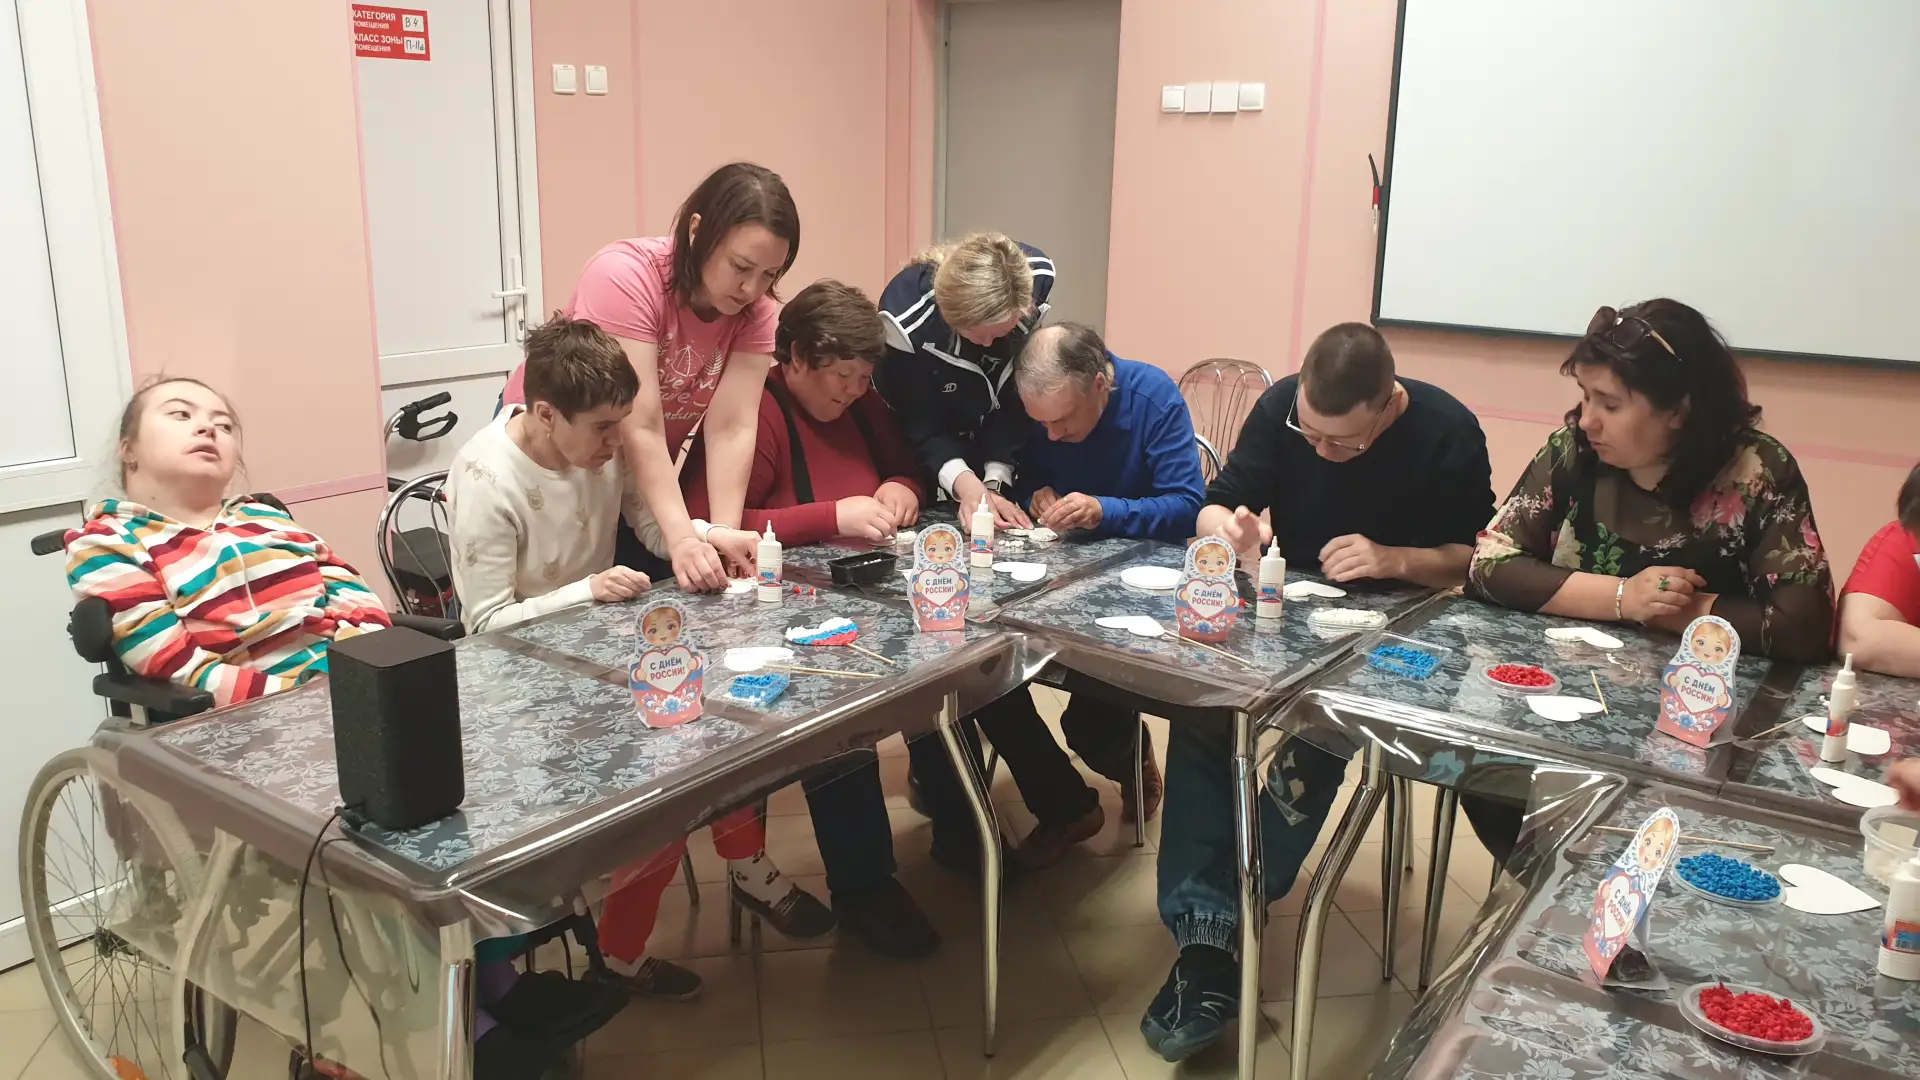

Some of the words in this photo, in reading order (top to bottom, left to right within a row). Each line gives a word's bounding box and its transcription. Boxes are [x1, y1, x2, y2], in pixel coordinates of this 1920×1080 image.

[381, 35, 403, 45] ЗОНЫ
[932, 577, 952, 586] ДНЁМ
[925, 586, 954, 594] РОССИИ!
[1194, 588, 1199, 596] С
[1201, 588, 1223, 599] ДНЁМ
[1191, 597, 1223, 607] РОССИИ!
[650, 662, 657, 670] С
[658, 657, 683, 670] ДНЁМ
[650, 666, 686, 681] РОССИИ!
[1684, 676, 1690, 684] С
[1691, 680, 1716, 693] ДНЁМ
[1681, 685, 1714, 705] РОССИИ!
